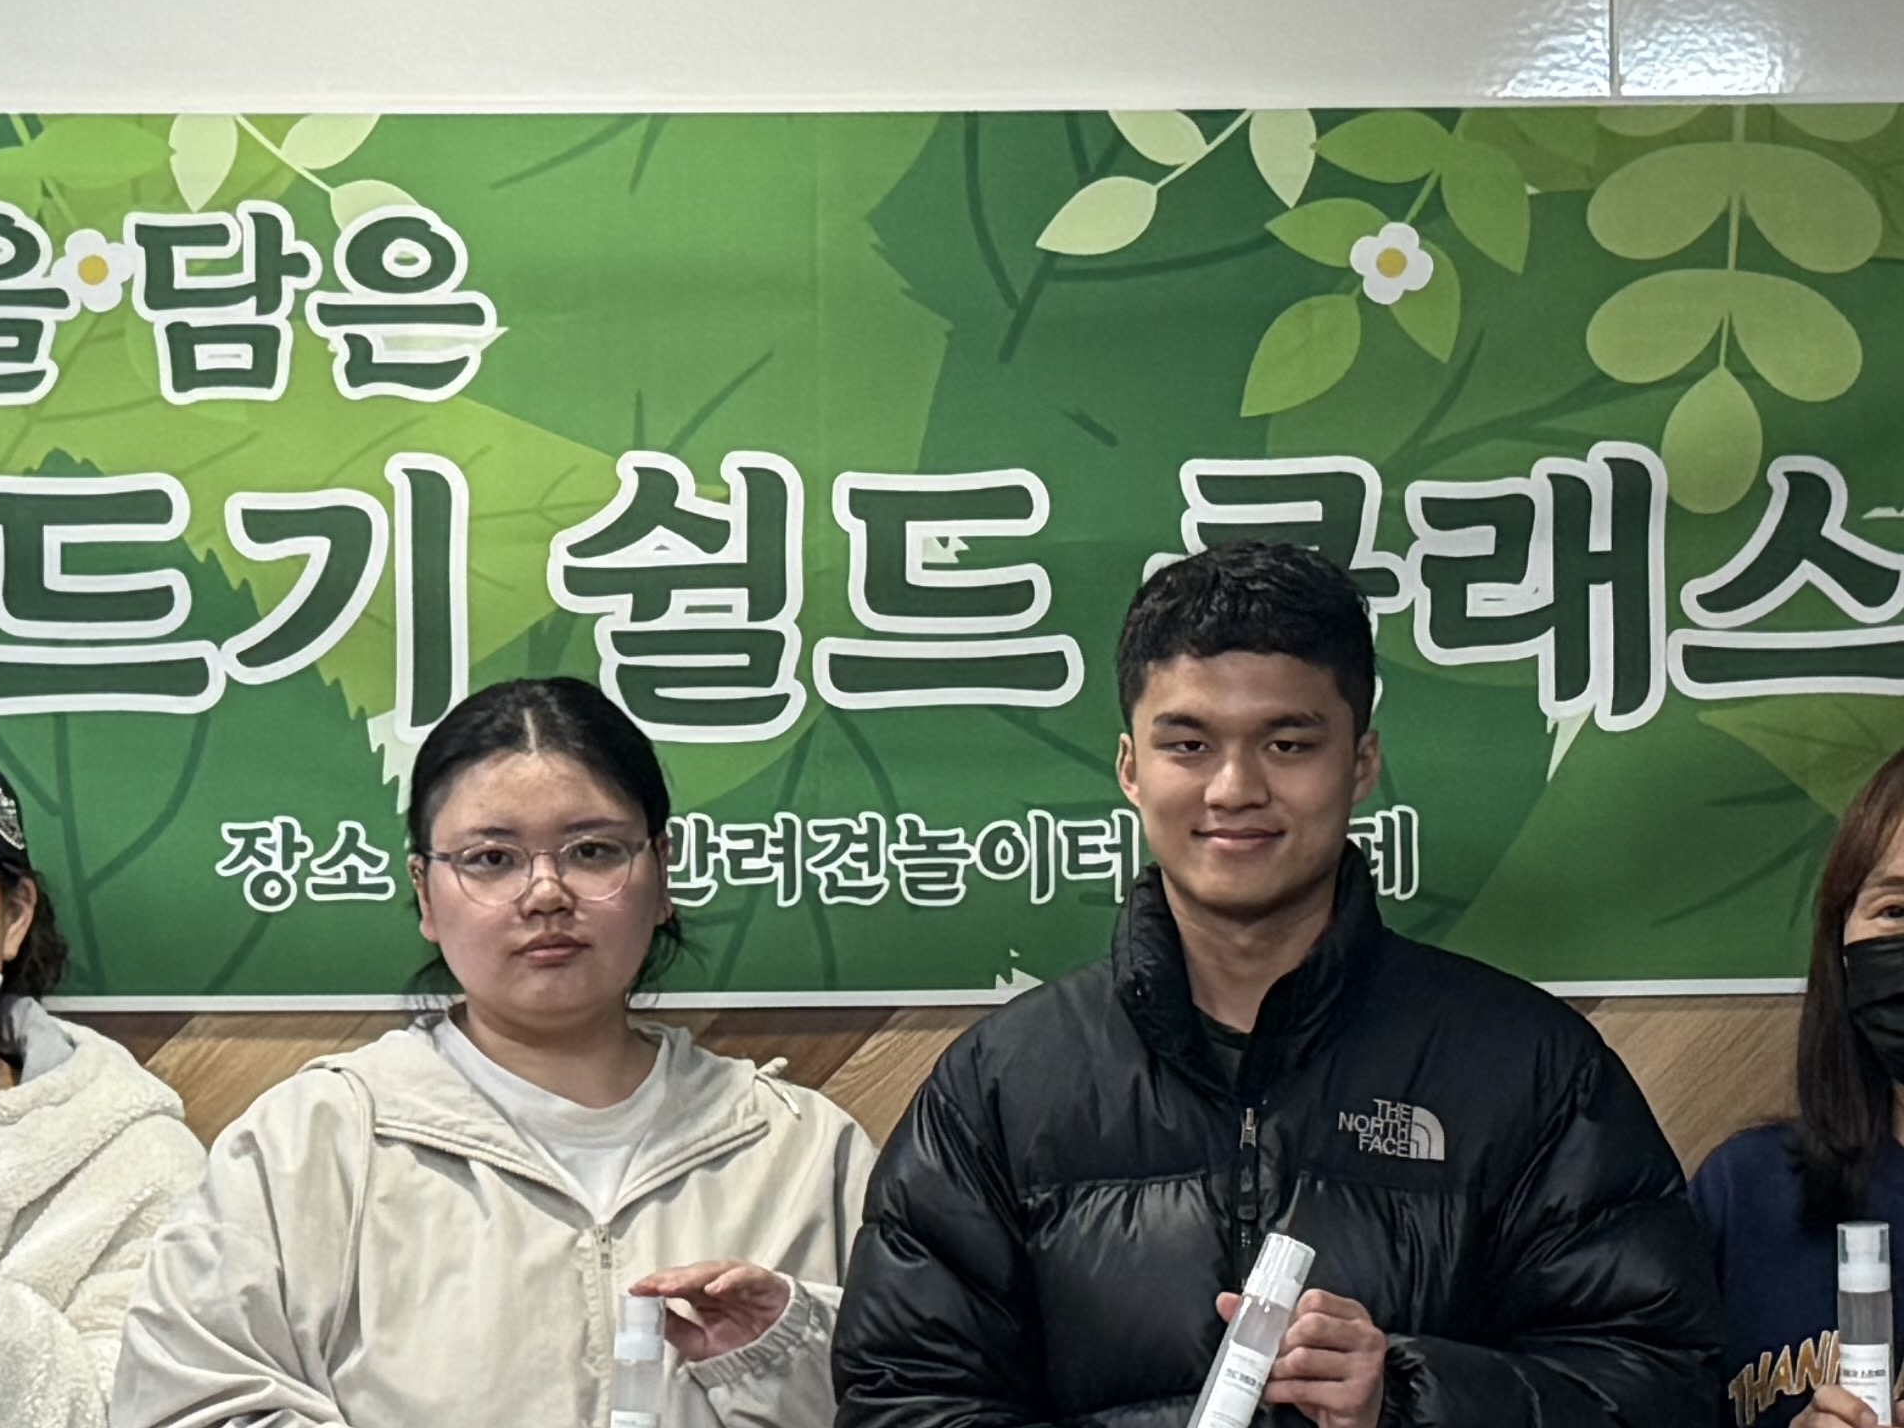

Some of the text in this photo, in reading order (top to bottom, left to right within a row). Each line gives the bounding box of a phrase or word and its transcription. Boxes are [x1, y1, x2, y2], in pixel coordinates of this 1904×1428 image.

[123, 199, 496, 401] 담은
[547, 451, 1084, 743] 쉴드
[215, 815, 395, 911] 장소
[1338, 1111, 1409, 1141] NORTH
[1373, 1098, 1414, 1123] THE
[1359, 1132, 1411, 1158] FACE
